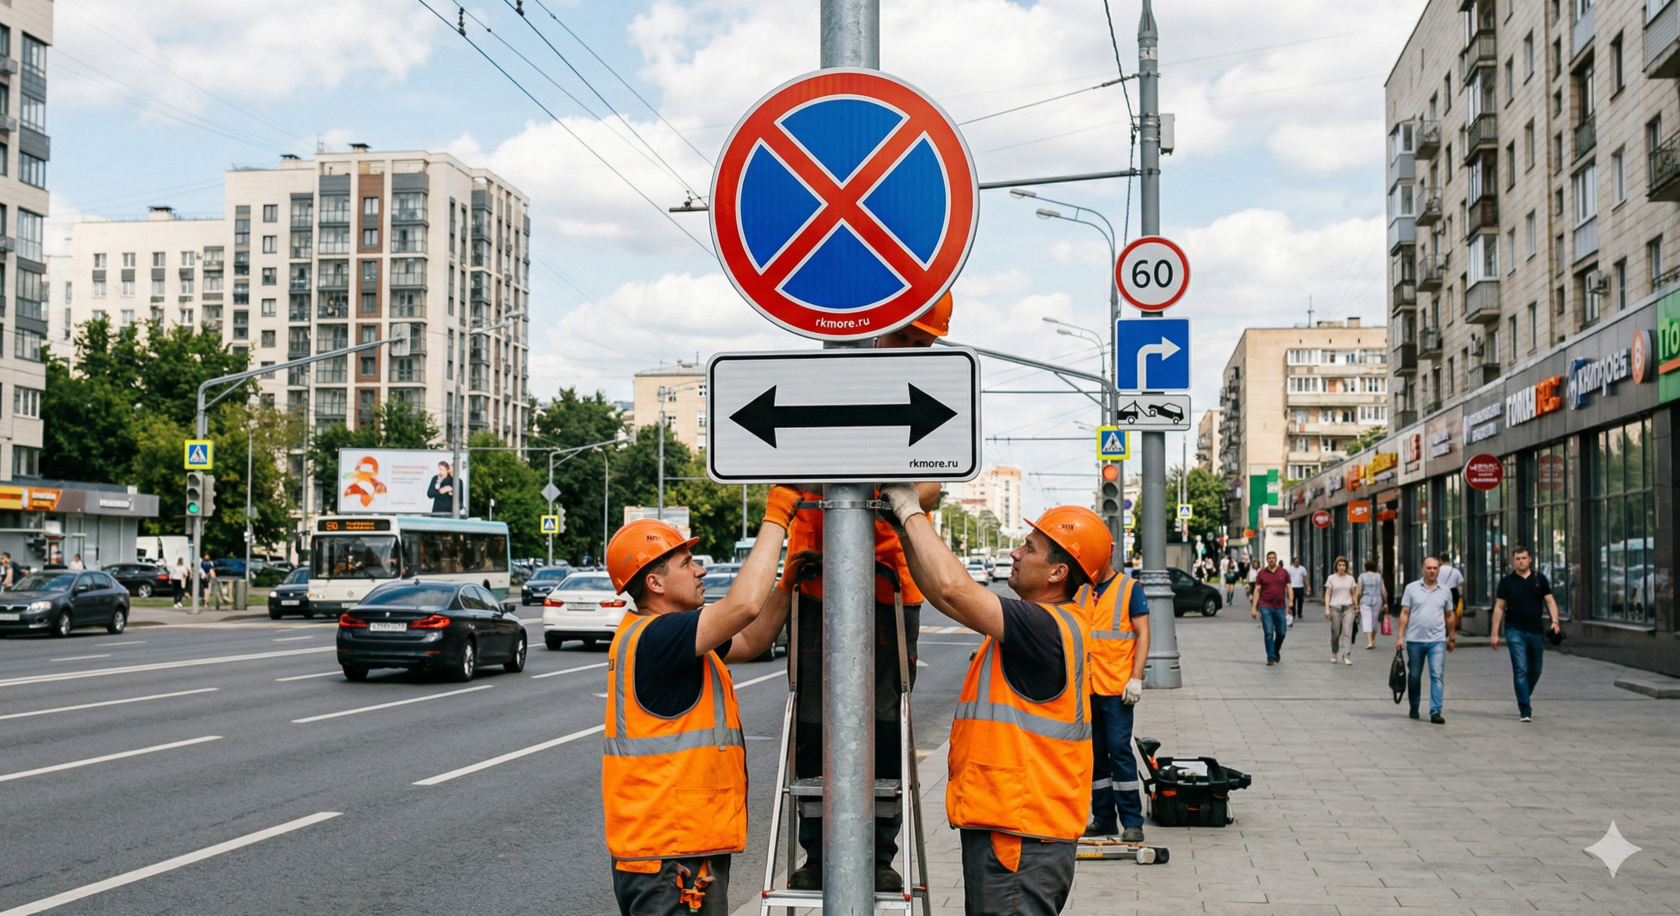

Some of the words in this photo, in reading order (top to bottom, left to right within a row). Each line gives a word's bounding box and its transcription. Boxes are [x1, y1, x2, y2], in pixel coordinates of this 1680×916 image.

[1132, 259, 1173, 288] 60
[815, 317, 870, 328] rkmore.ru
[909, 459, 958, 468] rkmore.ru
